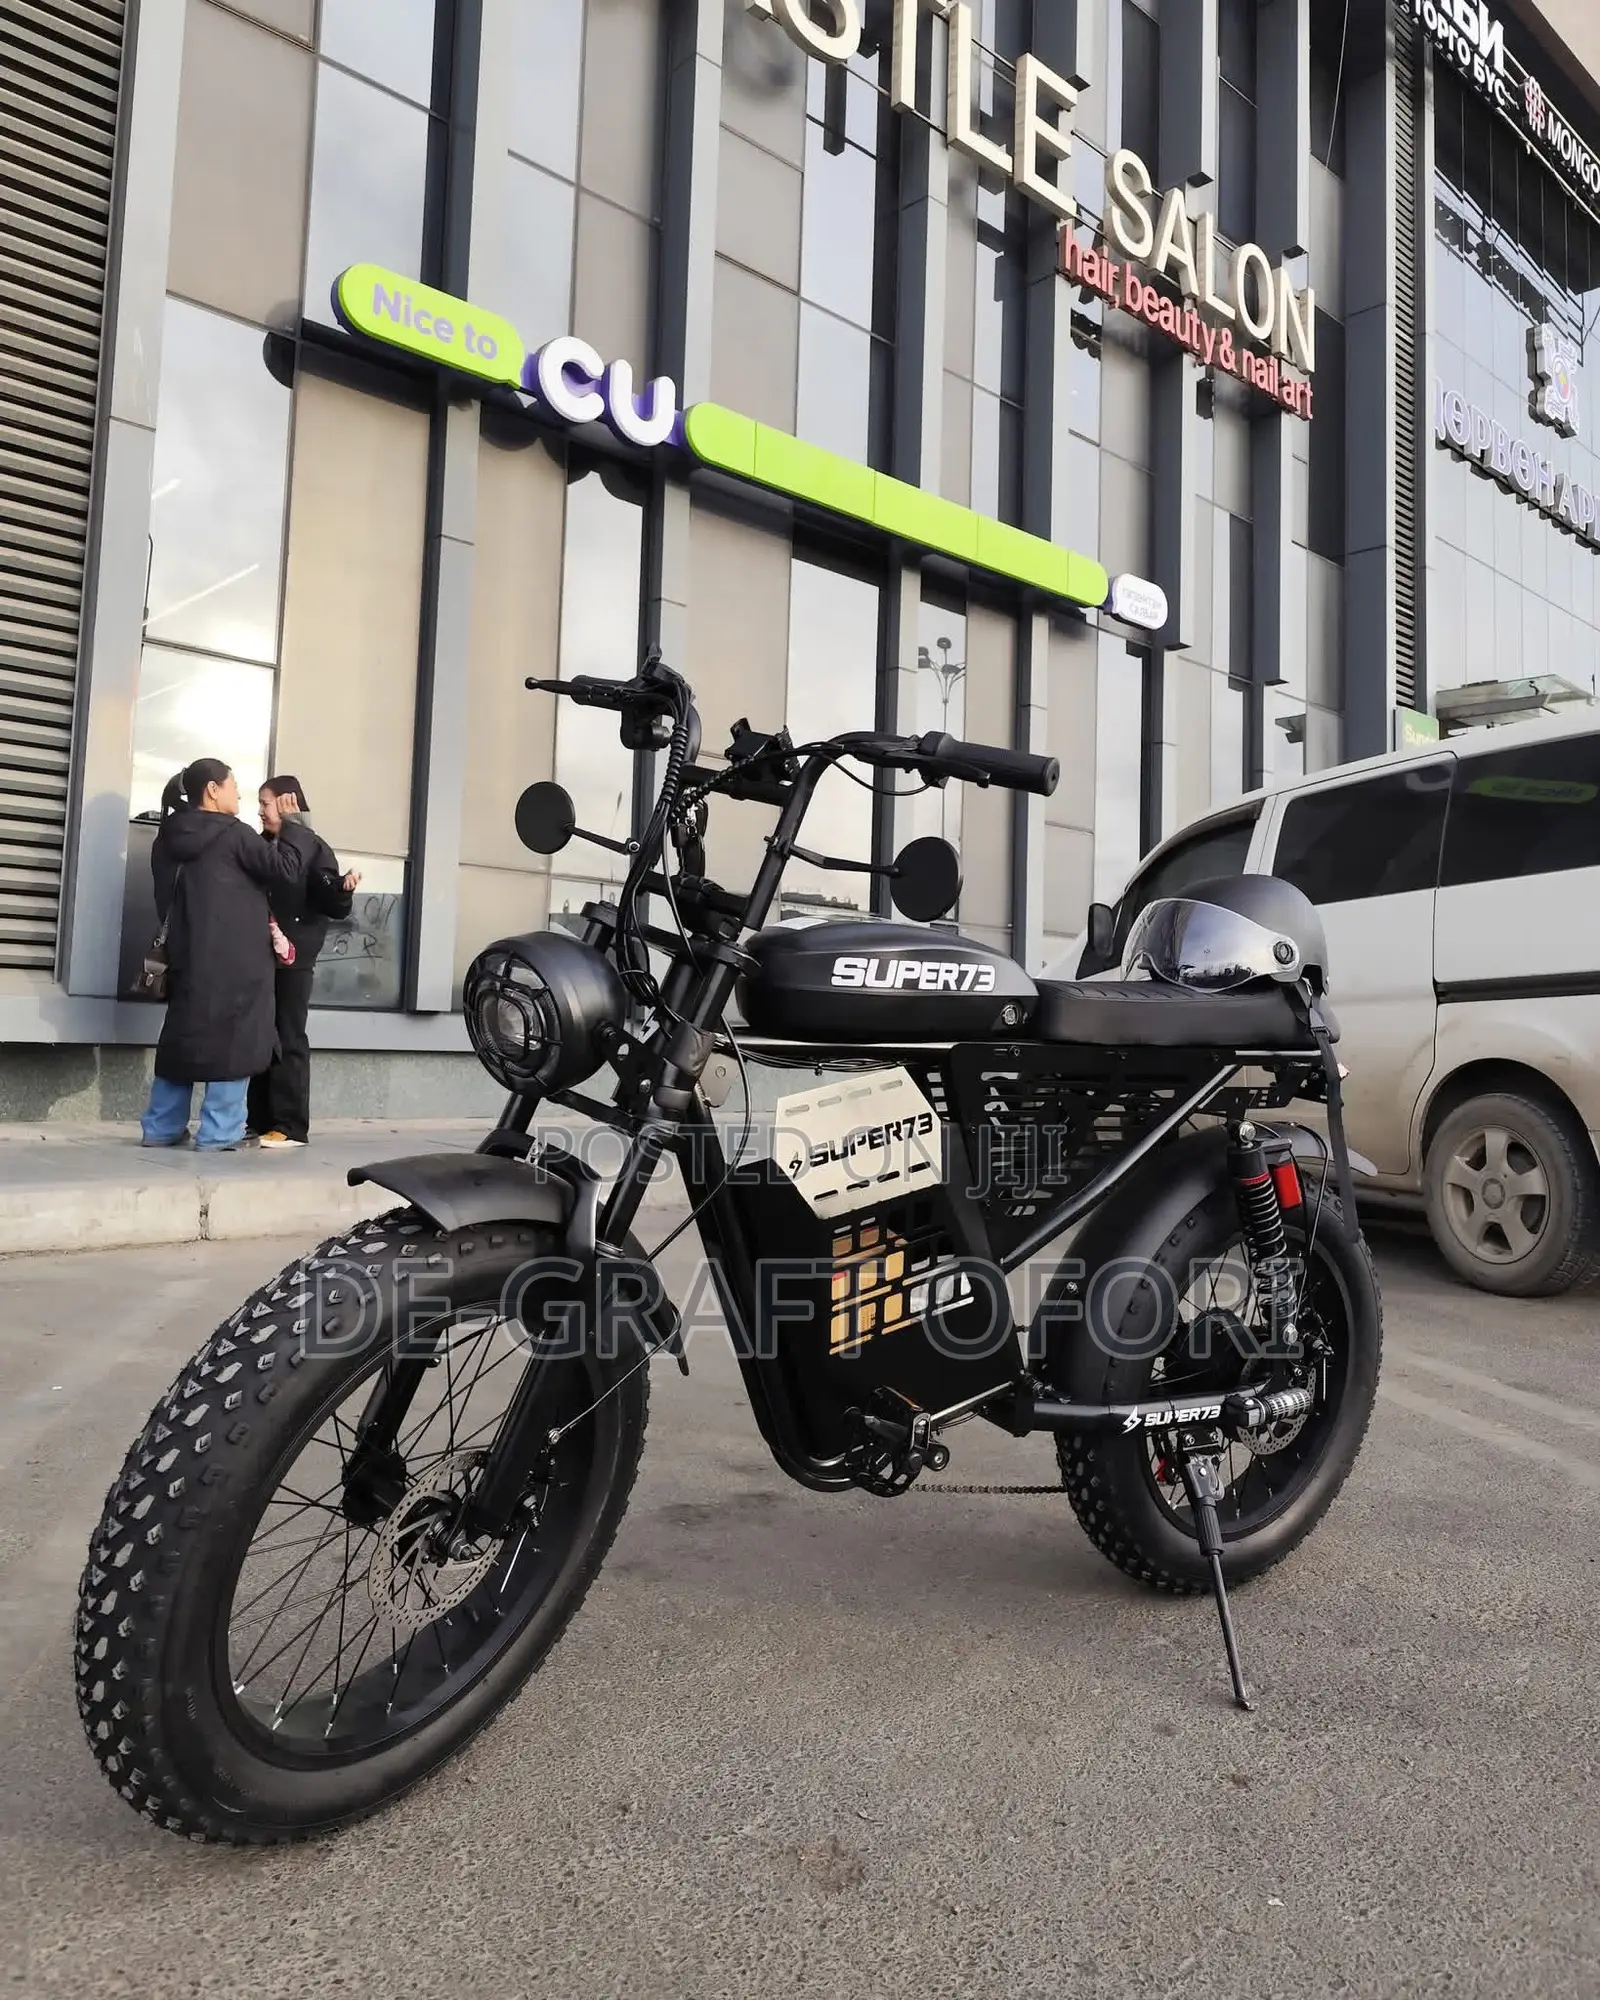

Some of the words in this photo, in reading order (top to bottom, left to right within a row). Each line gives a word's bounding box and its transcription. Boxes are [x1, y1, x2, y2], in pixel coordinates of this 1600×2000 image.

[1440, 0, 1504, 77] БИ
[745, 0, 1078, 219] TLE
[1105, 148, 1315, 375] SALON
[373, 282, 454, 345] Nice
[462, 321, 498, 360] to
[1059, 222, 1119, 309] hair,
[1123, 262, 1217, 366] beauty
[1219, 326, 1238, 374] &
[1242, 346, 1280, 397] nail
[1281, 374, 1313, 420] art
[1558, 471, 1600, 541] АР
[831, 957, 995, 992] SUPER73
[808, 1112, 933, 1168] SUPER73
[1144, 1404, 1222, 1428] SUPER73
